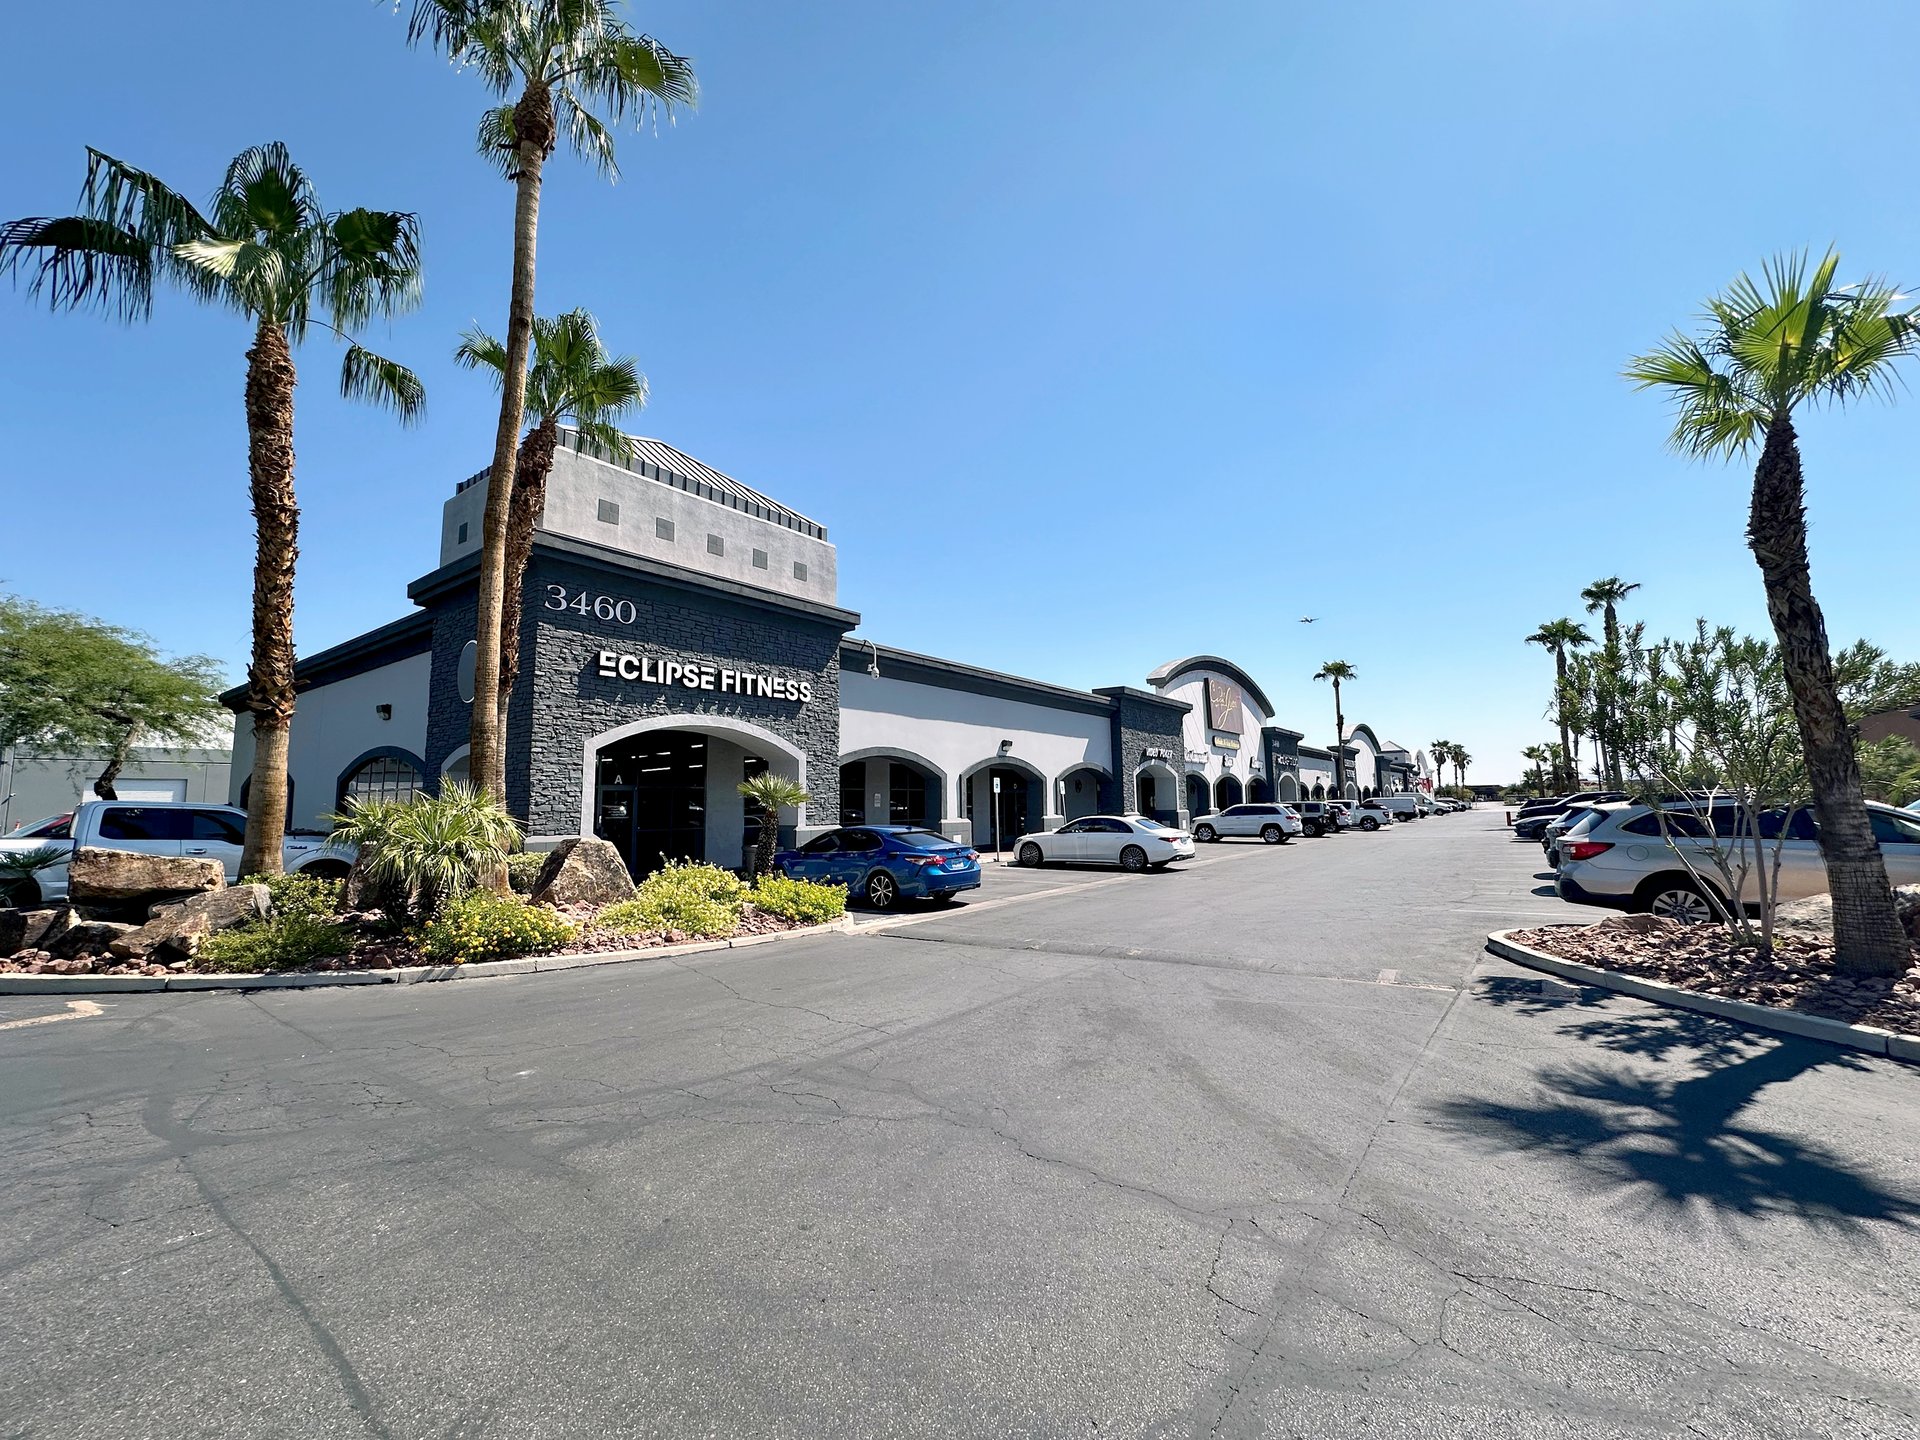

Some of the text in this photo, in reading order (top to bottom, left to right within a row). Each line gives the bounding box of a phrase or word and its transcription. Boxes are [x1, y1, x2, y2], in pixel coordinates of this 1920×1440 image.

[544, 584, 637, 624] 3460
[599, 650, 812, 703] ECLIPSE FITNESS
[614, 774, 623, 785] A
